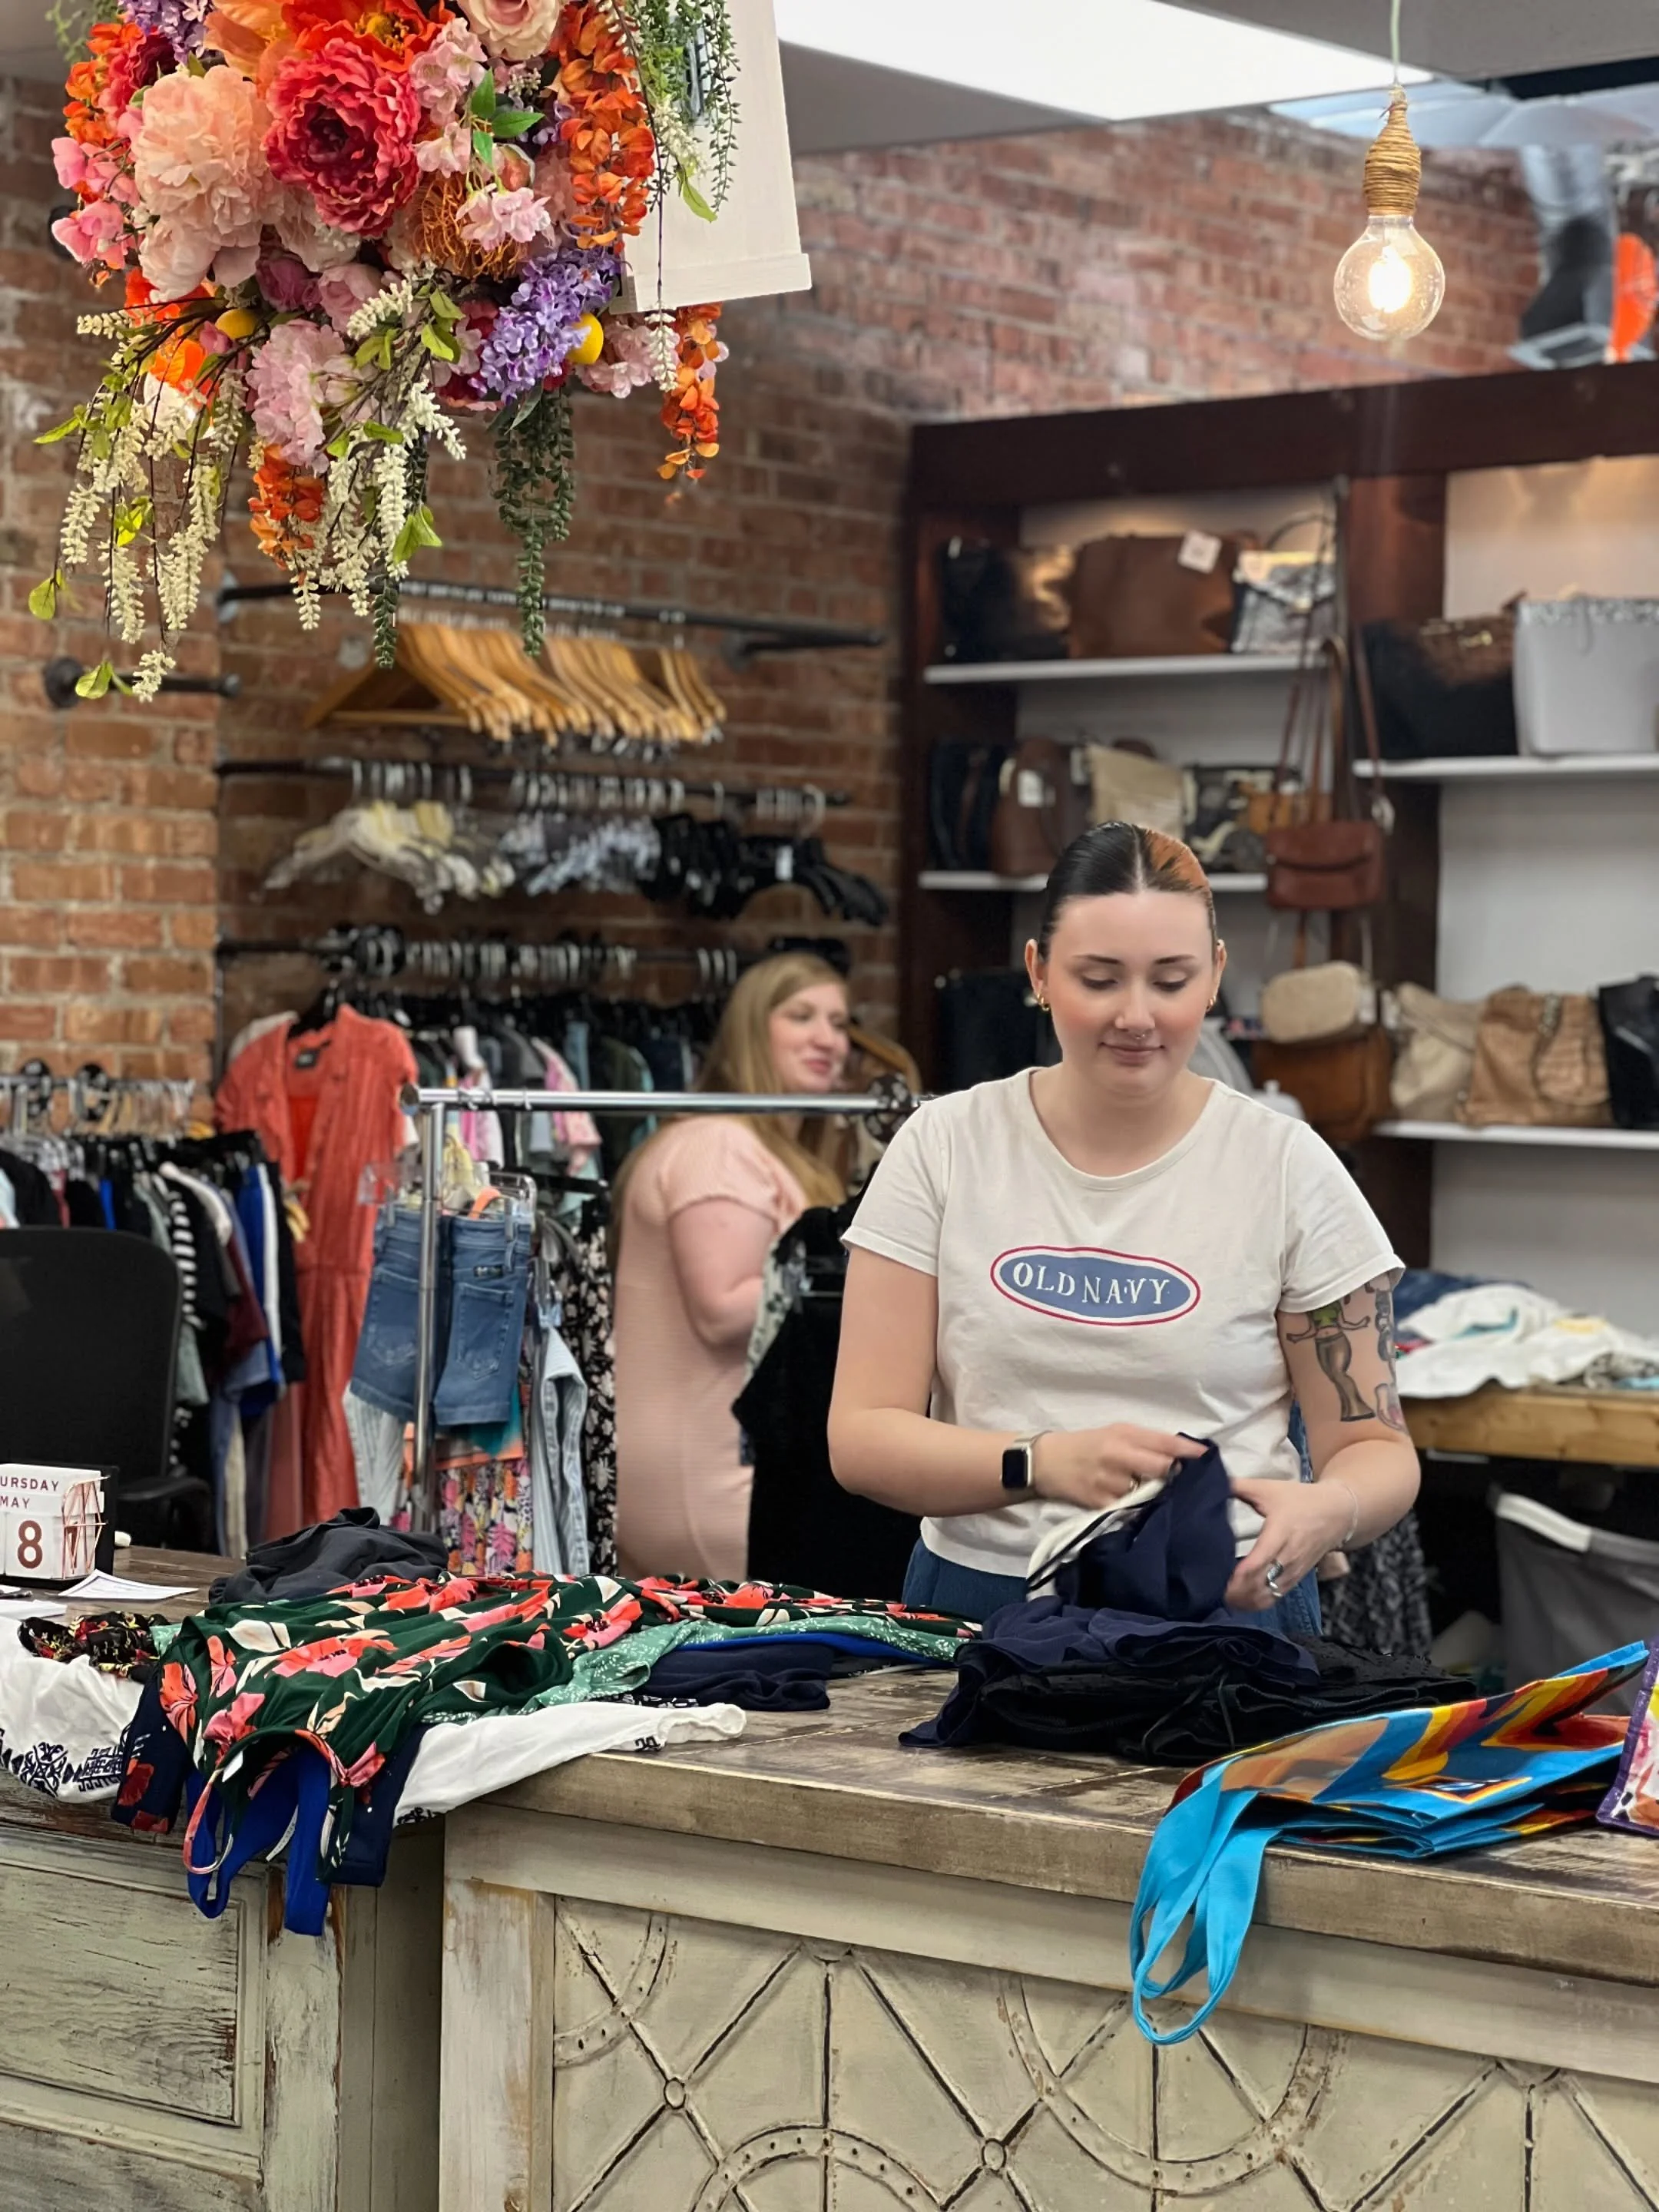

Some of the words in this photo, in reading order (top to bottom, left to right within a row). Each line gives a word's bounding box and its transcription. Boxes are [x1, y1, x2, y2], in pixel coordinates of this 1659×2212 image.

[1013, 1262, 1075, 1296] OLD
[1081, 1276, 1170, 1304] NAVY
[0, 1495, 30, 1509] MAY
[18, 1520, 43, 1569] 8
